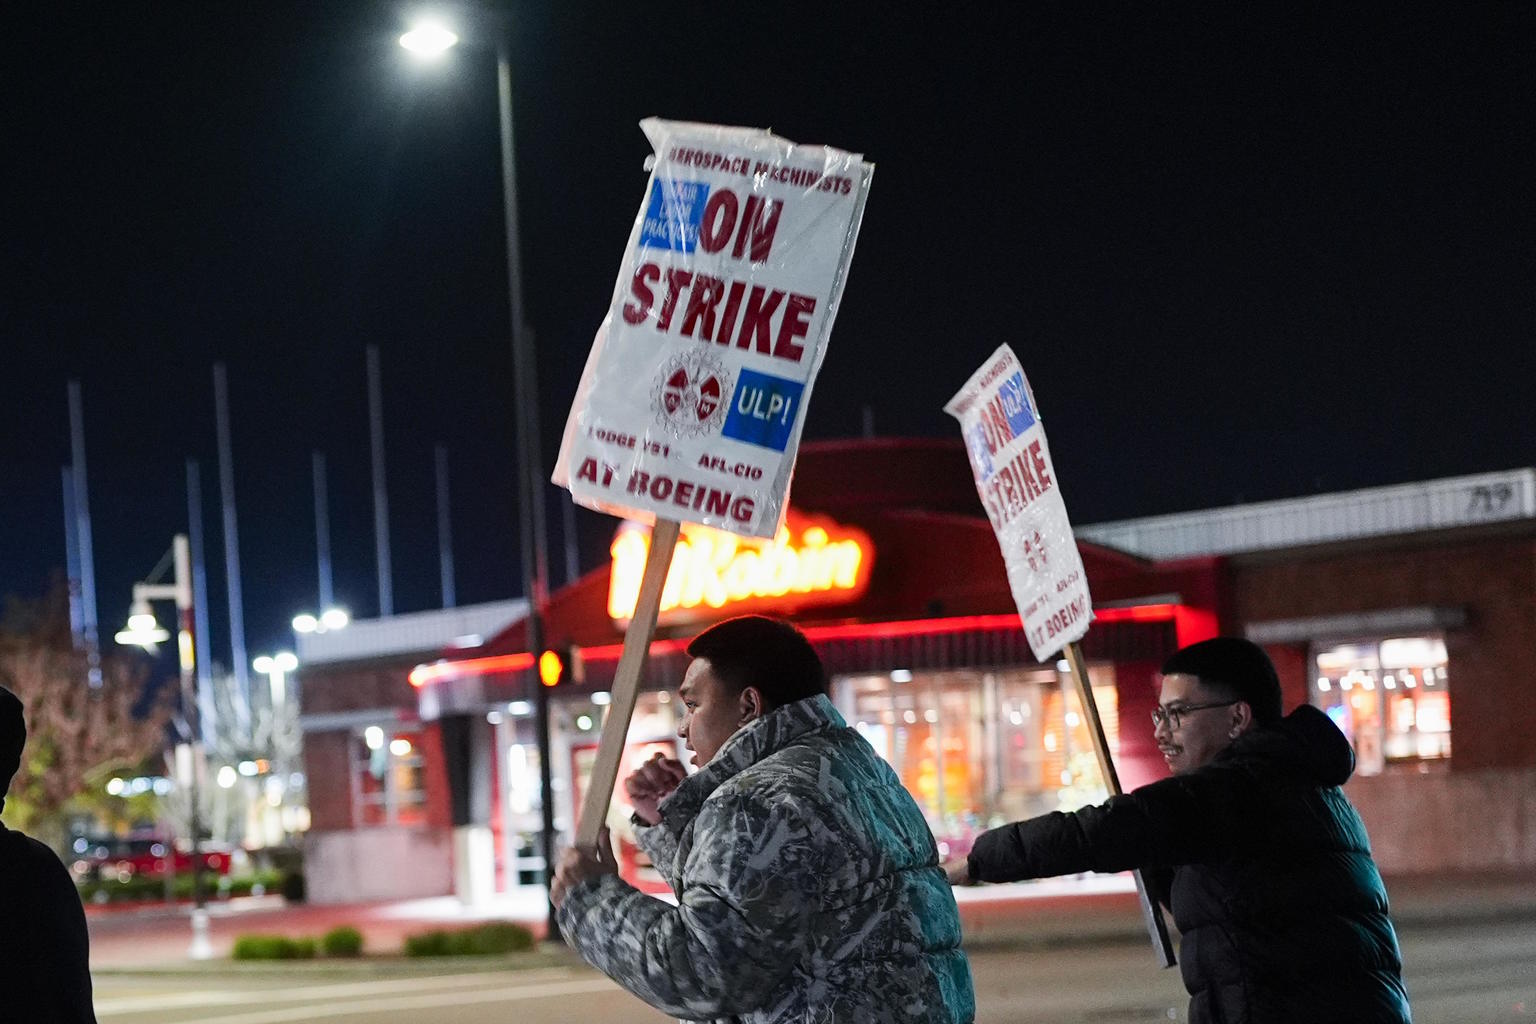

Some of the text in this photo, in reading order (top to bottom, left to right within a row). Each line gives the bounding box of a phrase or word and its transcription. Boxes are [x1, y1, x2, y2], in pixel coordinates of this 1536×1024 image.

[699, 187, 784, 264] ON
[623, 261, 817, 363] STRIKE
[737, 385, 792, 427] ULP!
[979, 394, 1015, 458] ON
[576, 456, 756, 523] AT BOEING
[698, 453, 763, 482] AFL-CIO
[987, 439, 1053, 530] STRIKE
